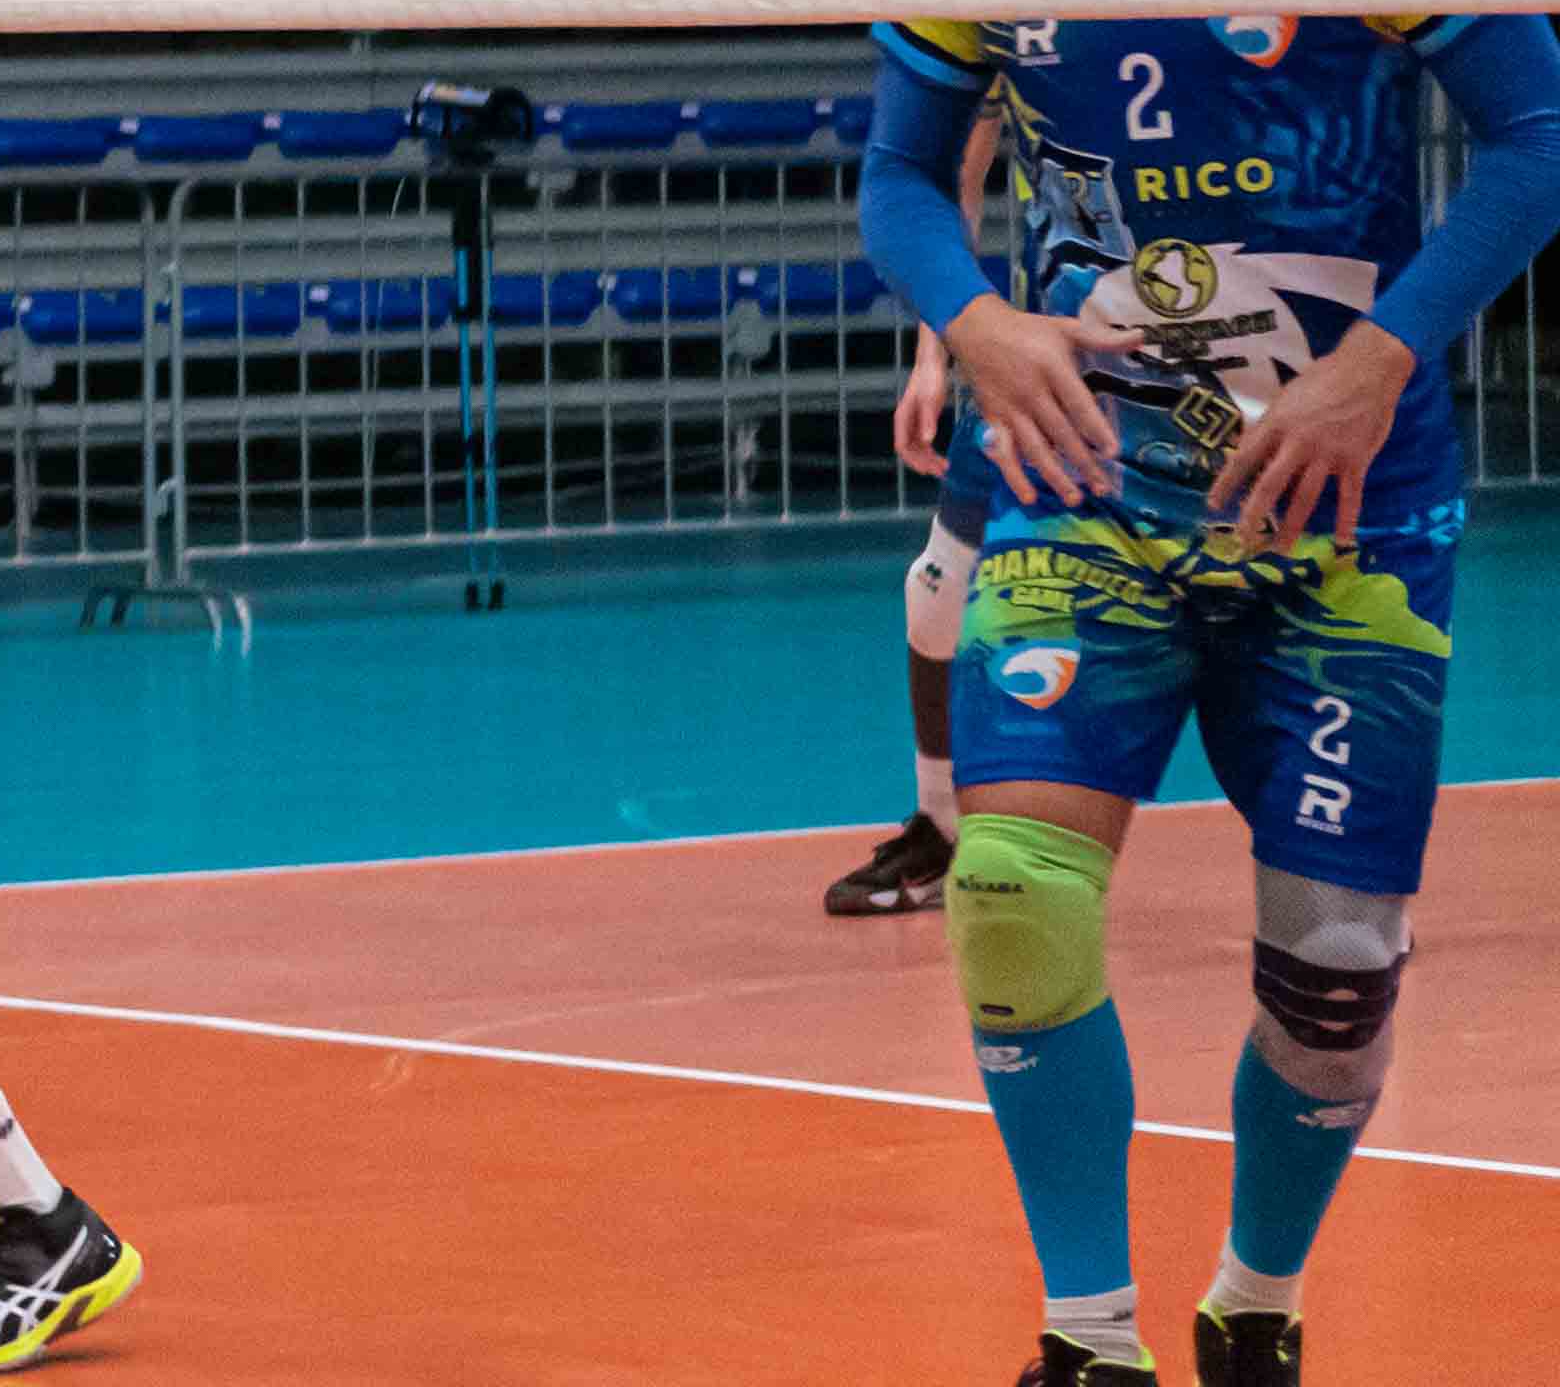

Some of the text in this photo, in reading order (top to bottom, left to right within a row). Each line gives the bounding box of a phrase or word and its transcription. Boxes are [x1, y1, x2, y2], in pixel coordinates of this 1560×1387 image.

[1118, 52, 1174, 140] 2
[1132, 157, 1275, 203] RICO
[1308, 694, 1352, 764] 2
